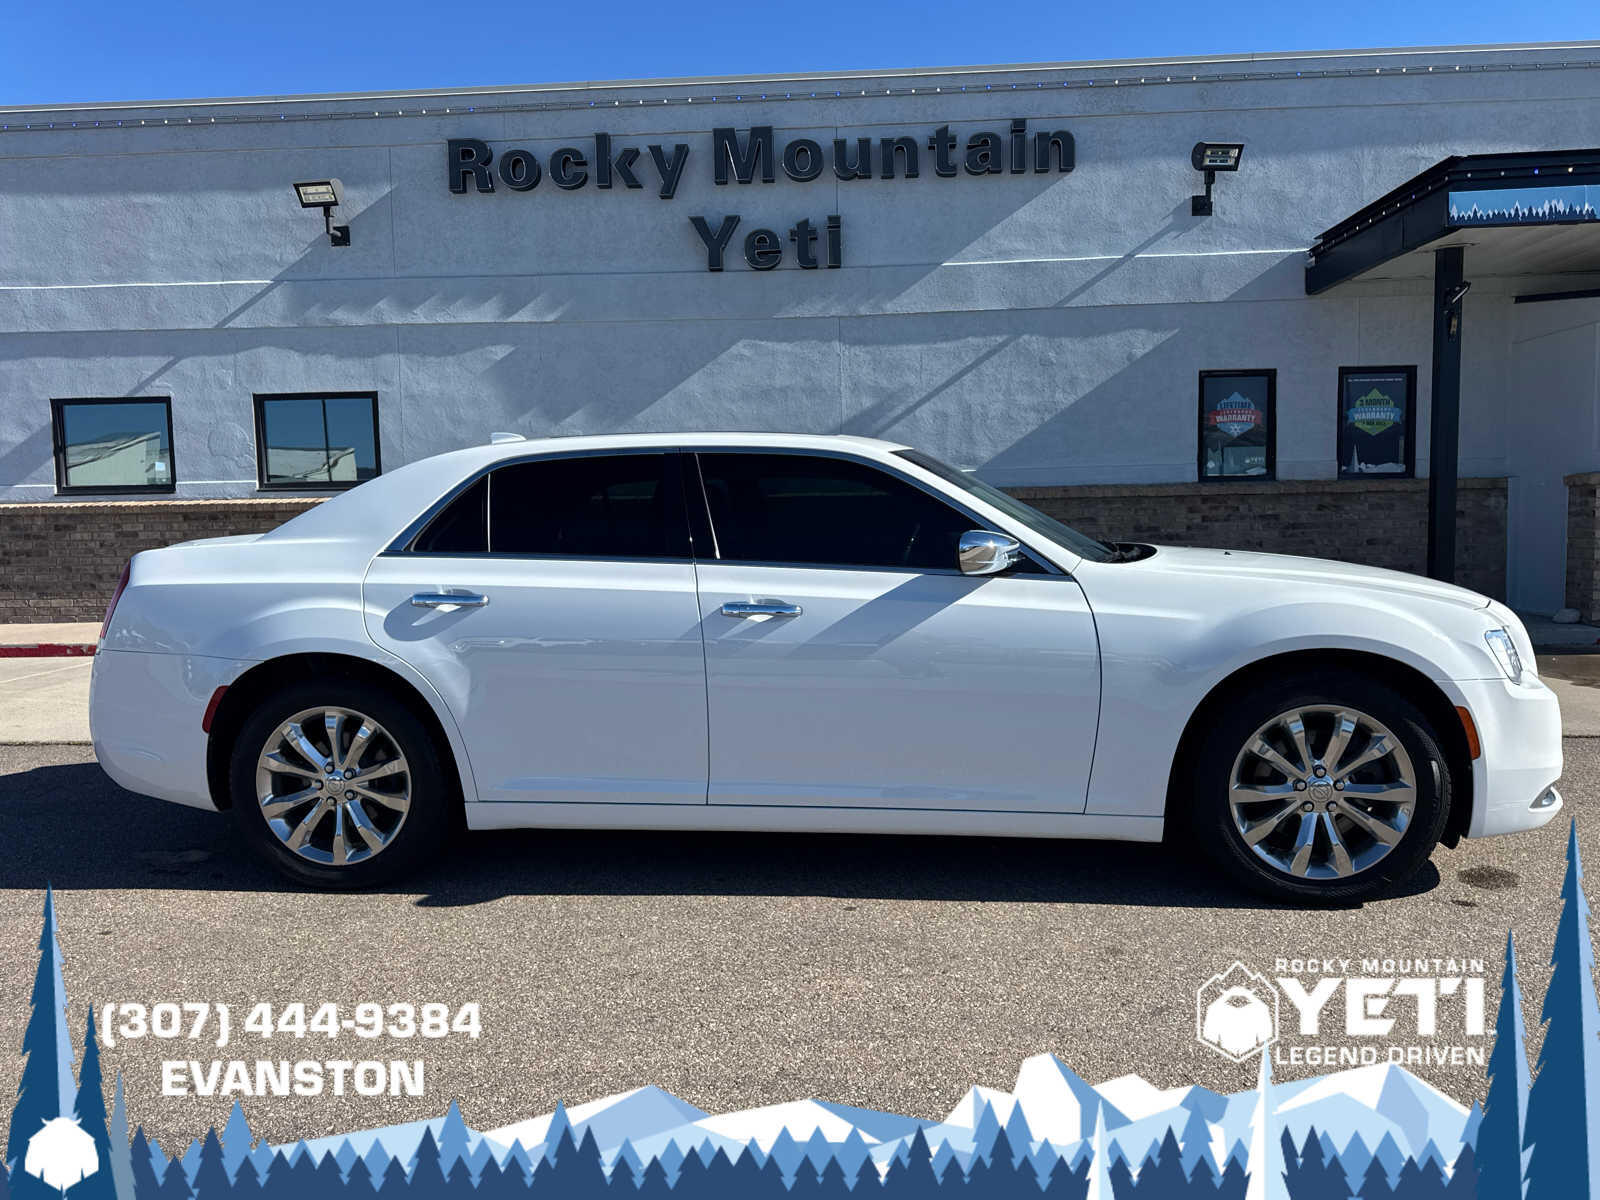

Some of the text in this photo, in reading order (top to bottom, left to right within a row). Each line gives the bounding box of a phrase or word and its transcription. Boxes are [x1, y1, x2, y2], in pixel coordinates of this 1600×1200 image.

[447, 119, 1076, 200] Rocky Mountain
[688, 214, 842, 272] Yeti
[1215, 413, 1256, 423] WARRANTY
[1354, 411, 1395, 421] WARRANTY
